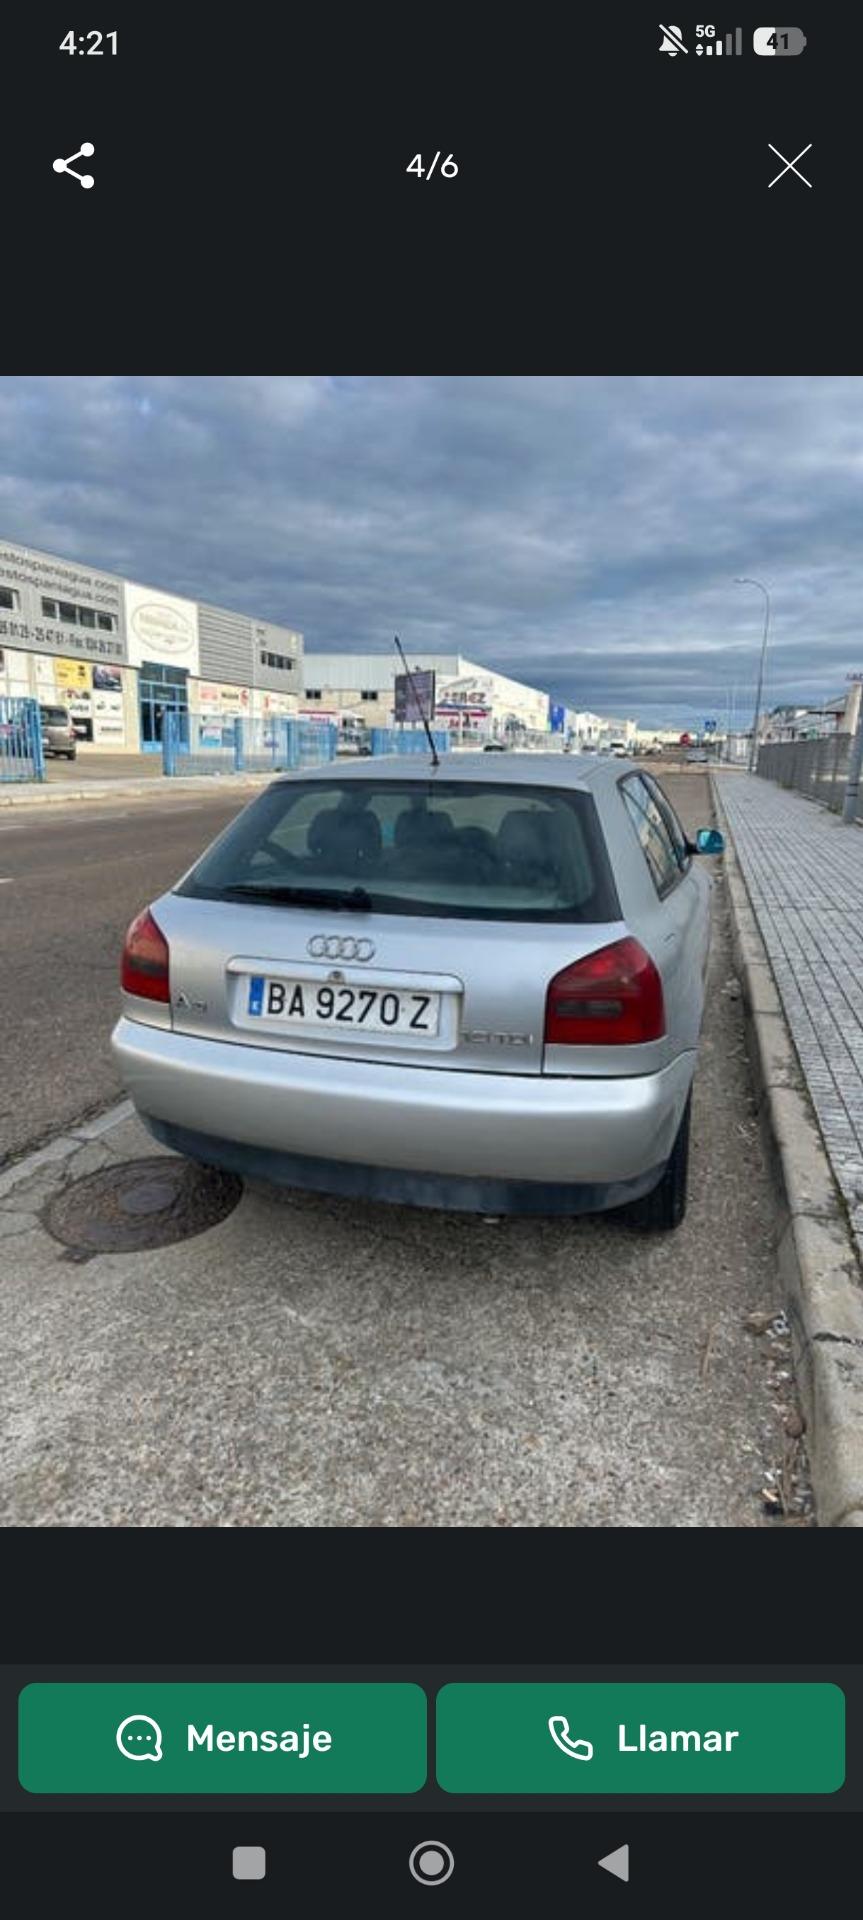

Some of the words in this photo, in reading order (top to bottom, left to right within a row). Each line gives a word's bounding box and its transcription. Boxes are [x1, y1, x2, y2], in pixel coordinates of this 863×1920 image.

[267, 982, 305, 1018] BA
[316, 987, 400, 1026] 9270
[409, 996, 431, 1030] Z
